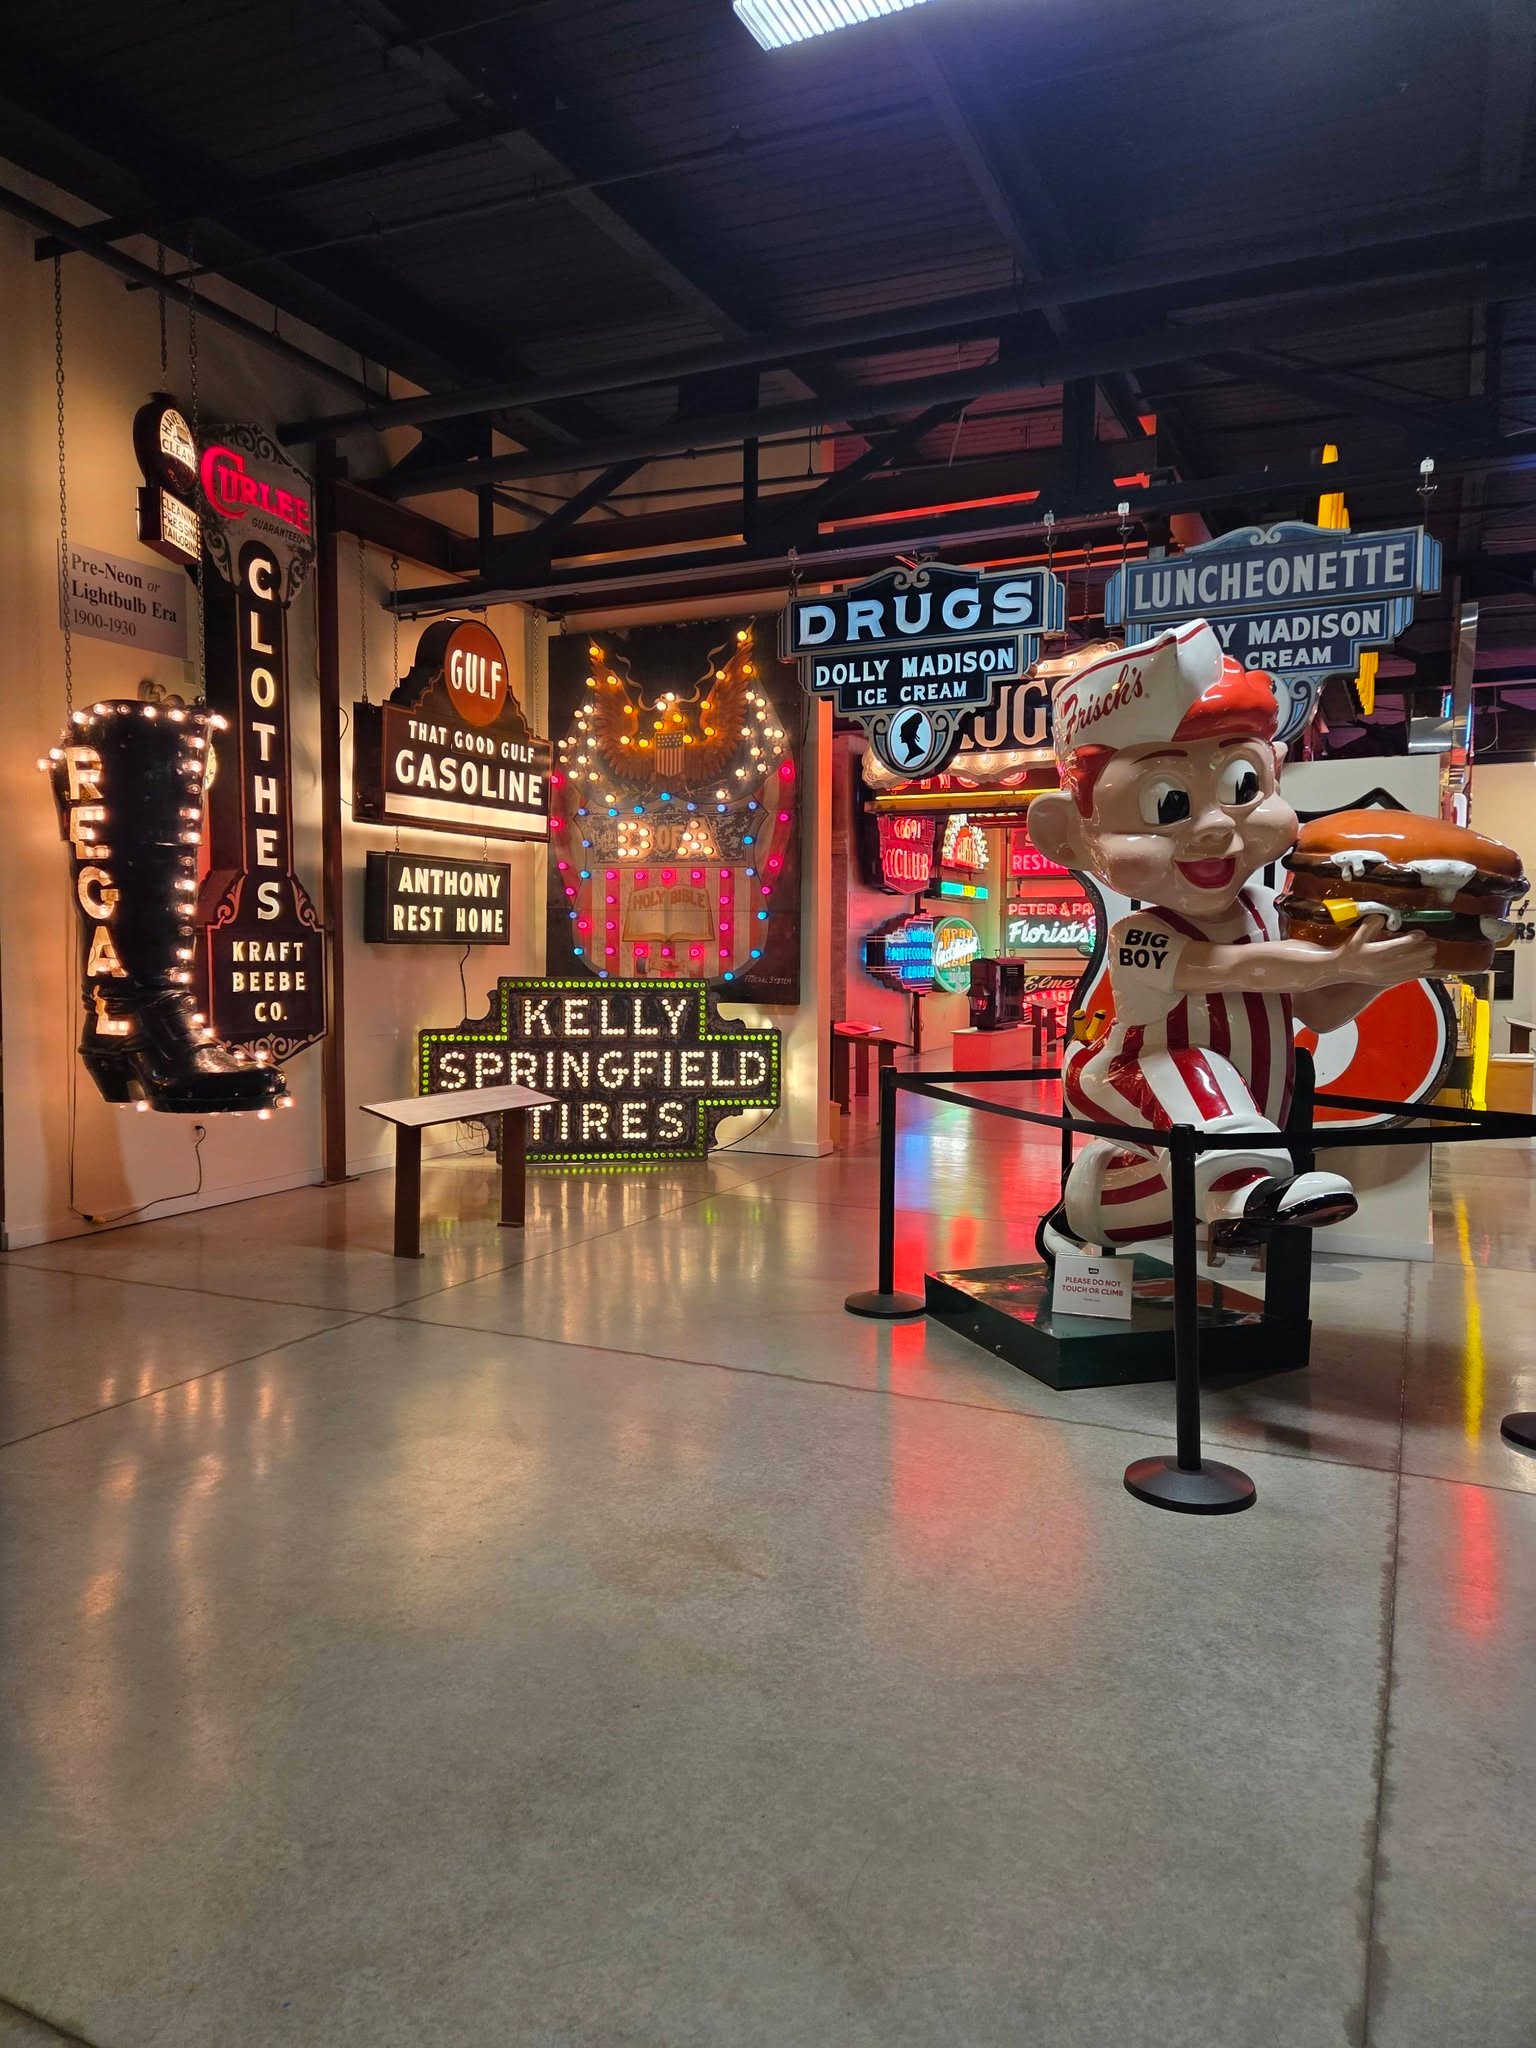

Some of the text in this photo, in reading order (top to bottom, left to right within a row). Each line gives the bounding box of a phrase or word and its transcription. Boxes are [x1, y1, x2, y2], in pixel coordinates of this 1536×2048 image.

[201, 445, 310, 534] CURLEE
[71, 553, 160, 593] Pre-Neon or
[1134, 543, 1406, 611] LUNCHEONETTE
[71, 580, 177, 623] Lightbulb Era
[798, 580, 1033, 645] DRUGS
[74, 609, 136, 637] 1900-1930
[1248, 609, 1381, 646] MADISON
[450, 649, 502, 700] GULF
[815, 648, 1014, 687] DOLLY MADISON
[1244, 646, 1332, 670] CREAM
[857, 681, 967, 706] ICE CREAM
[1061, 664, 1143, 734] Frisch's
[248, 558, 280, 920] CLOTHES
[408, 720, 534, 763] THAT GOOD GULF
[395, 750, 542, 806] GASOLINE
[894, 848, 929, 880] CLUB
[65, 746, 129, 1035] REGAL
[398, 866, 501, 899] ANTHONY
[633, 888, 706, 910] HOLY BIBLE
[393, 904, 503, 933] REST HOME
[1008, 903, 1058, 915] PETER
[1060, 901, 1070, 917] &
[1008, 919, 1090, 943] Florists
[1125, 929, 1169, 948] BIG
[1514, 922, 1535, 940] RS
[232, 941, 304, 963] KRAFT
[1120, 948, 1169, 969] BOY
[232, 972, 306, 993] BEEBE
[254, 1002, 288, 1022] CO.
[524, 998, 687, 1036] KELLY
[439, 1051, 766, 1089] SPRINGFIELD
[525, 1102, 684, 1141] TIRES
[1062, 1285, 1124, 1297] TOUCH OR CLIMB
[1065, 1276, 1091, 1286] PLEASE
[1105, 1280, 1121, 1288] NOT
